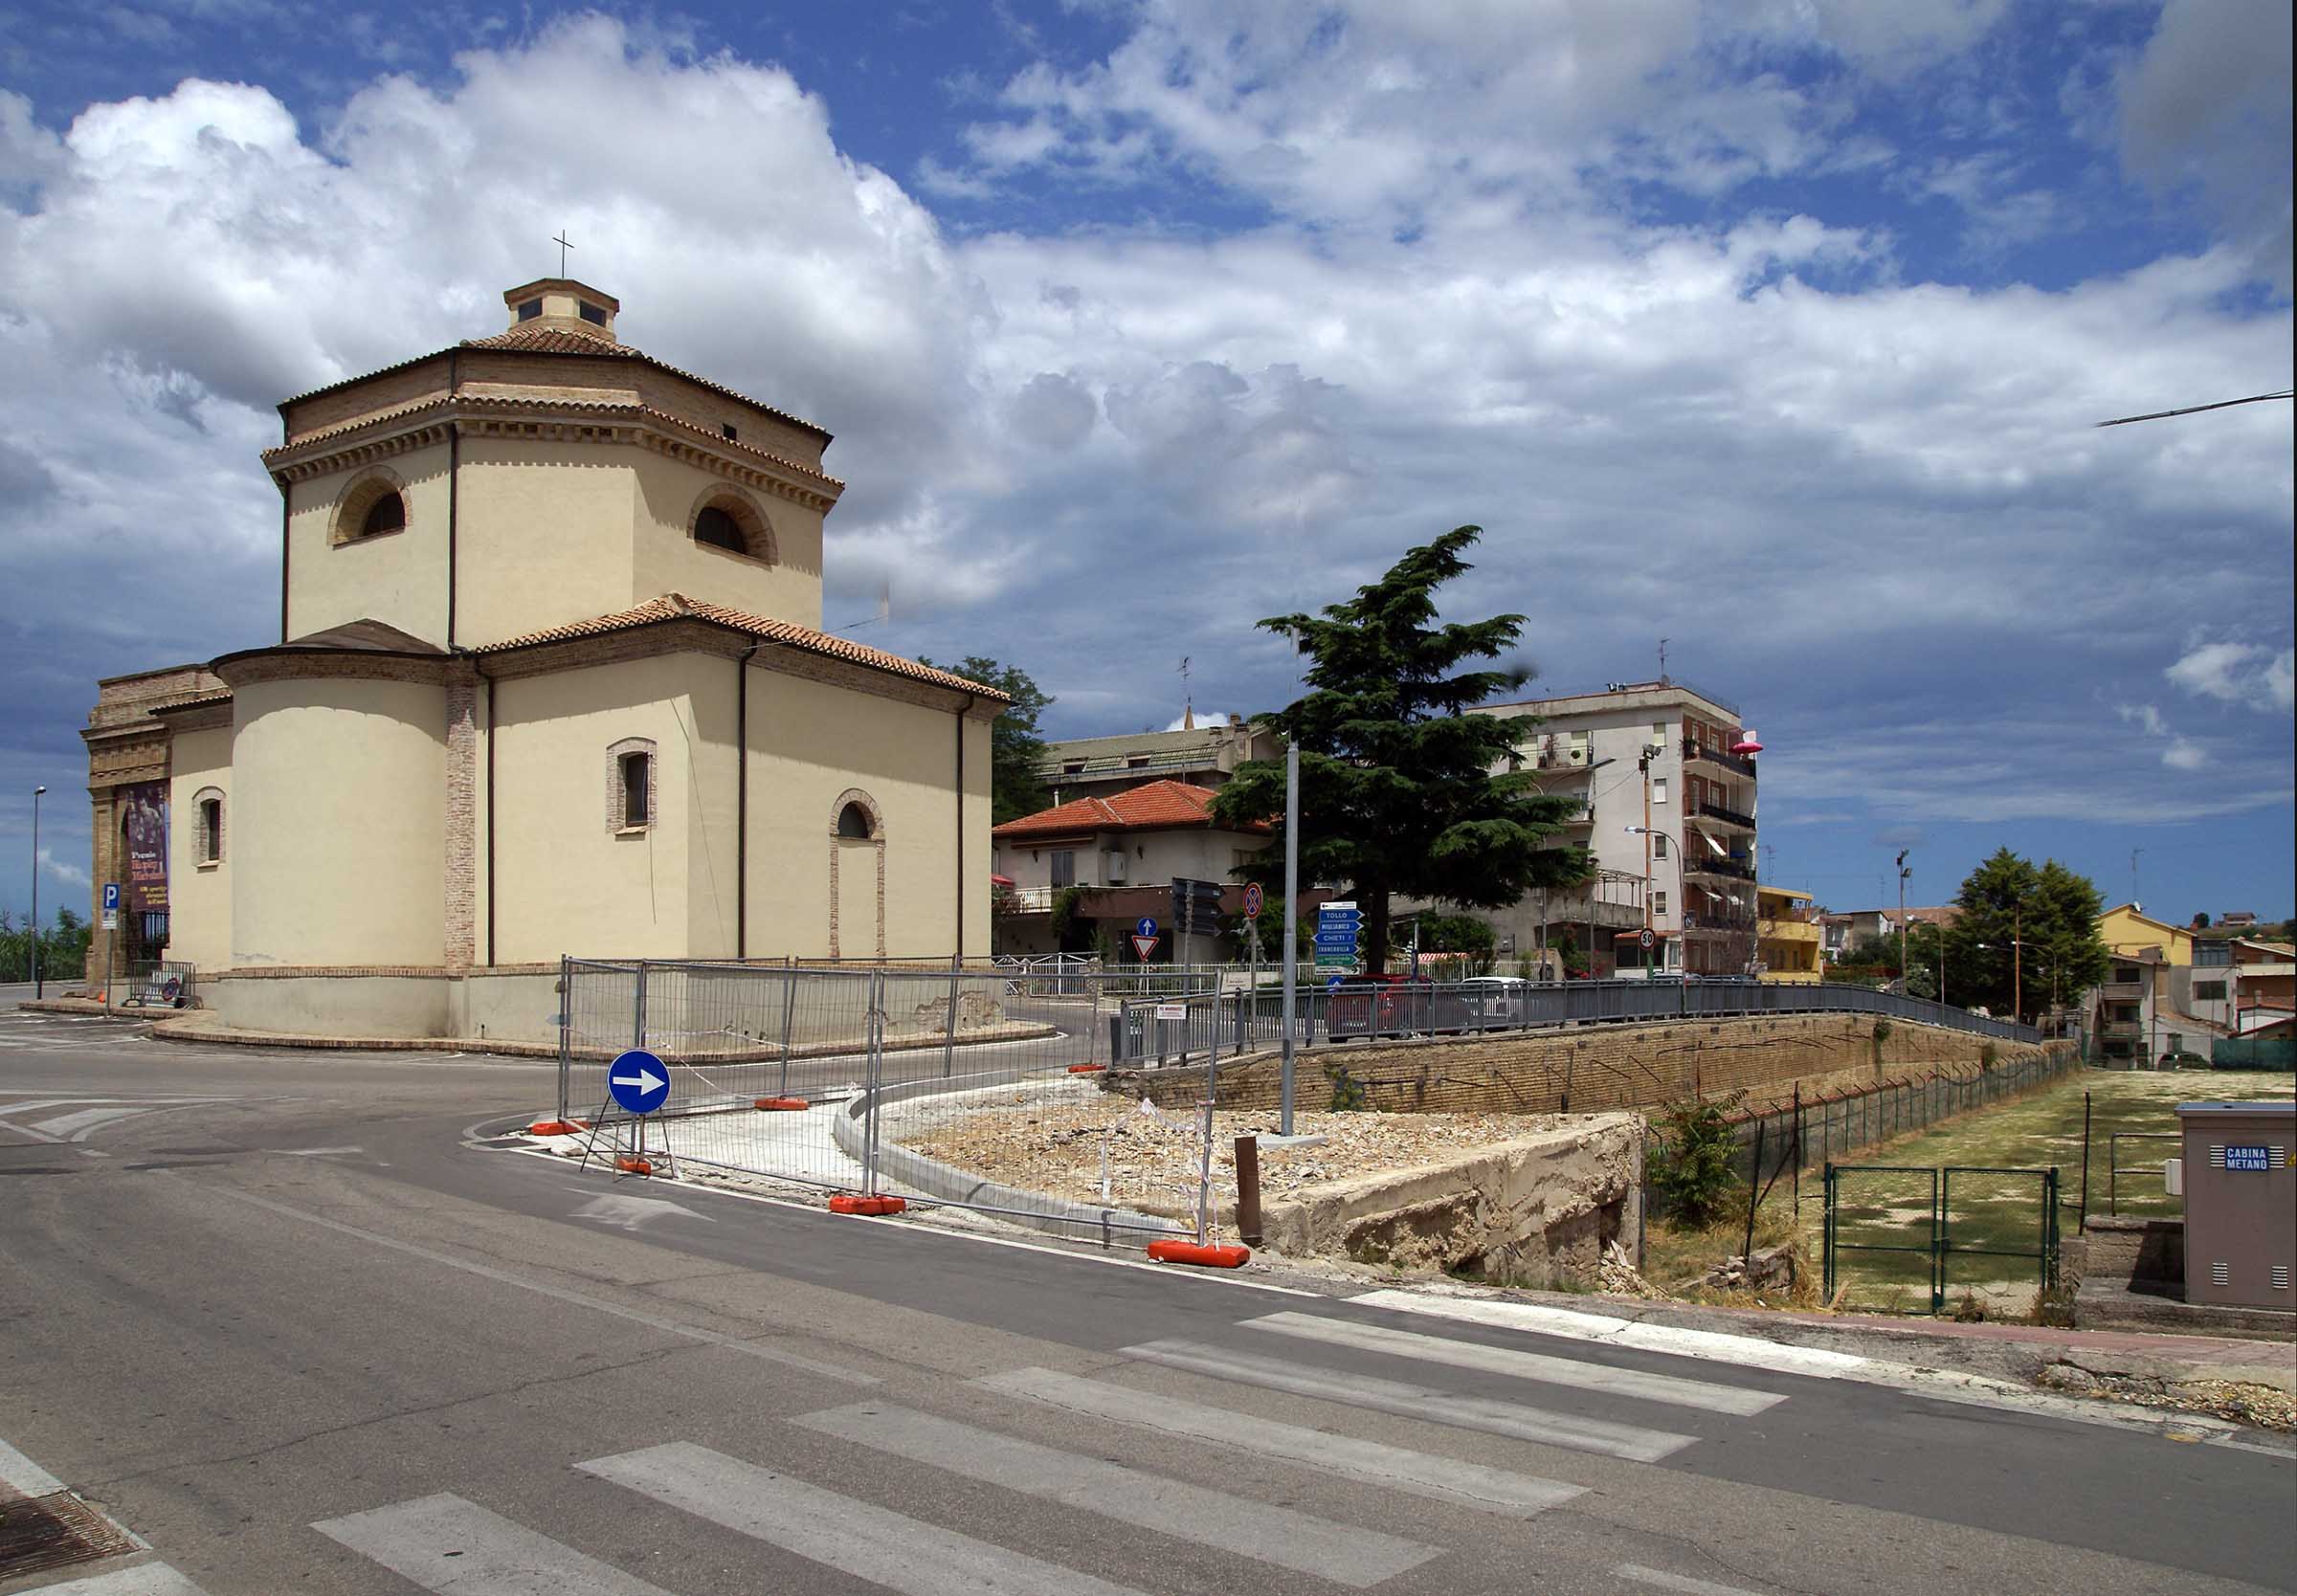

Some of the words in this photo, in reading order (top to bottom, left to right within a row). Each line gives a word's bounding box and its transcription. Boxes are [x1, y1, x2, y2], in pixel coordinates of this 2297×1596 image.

[106, 886, 117, 907] P
[1642, 933, 1653, 943] 50
[2227, 1147, 2266, 1159] CABINA
[2227, 1159, 2267, 1169] METANO
